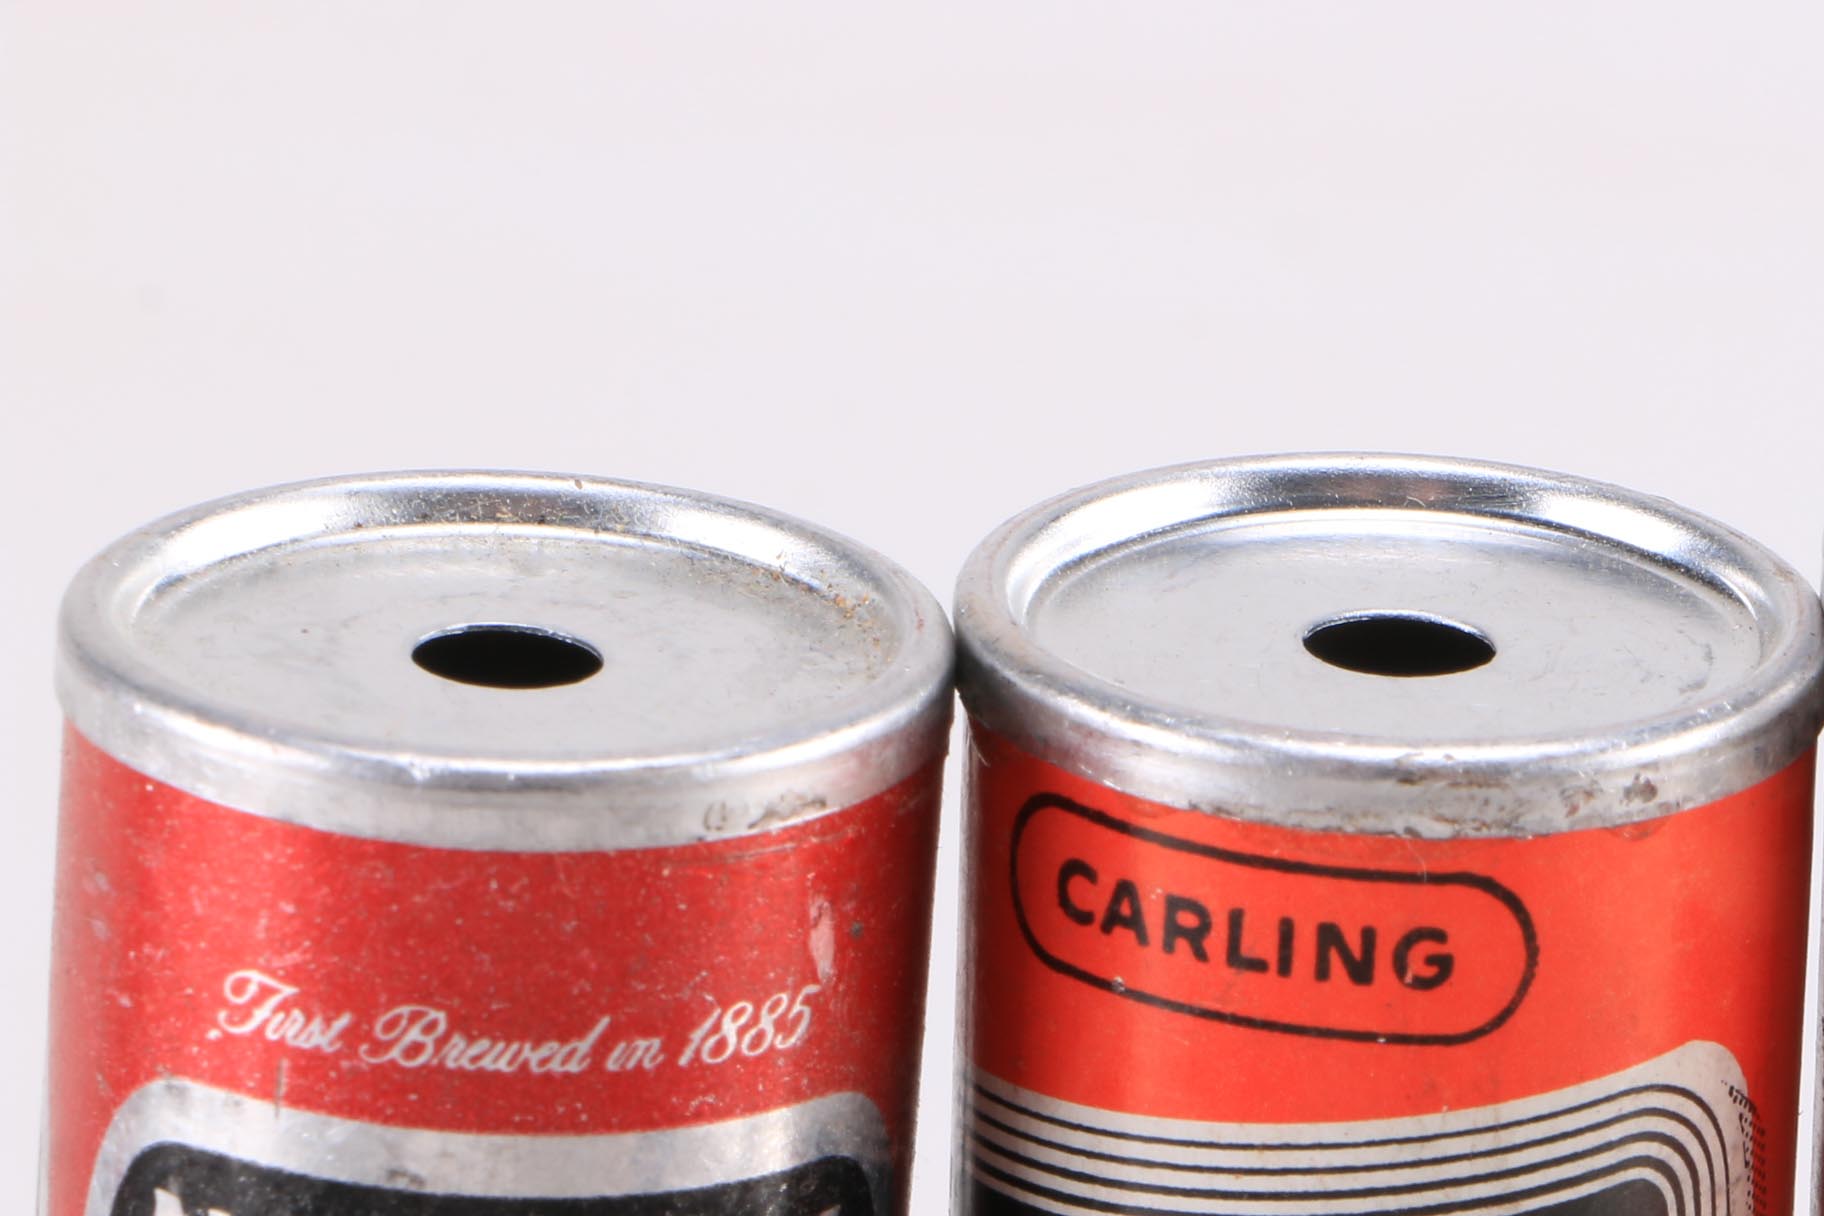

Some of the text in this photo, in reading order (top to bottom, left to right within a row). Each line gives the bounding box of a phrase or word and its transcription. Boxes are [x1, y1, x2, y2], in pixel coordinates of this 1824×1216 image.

[1055, 857, 1455, 991] CARLING
[217, 969, 820, 1074] First Brewed in 1885
